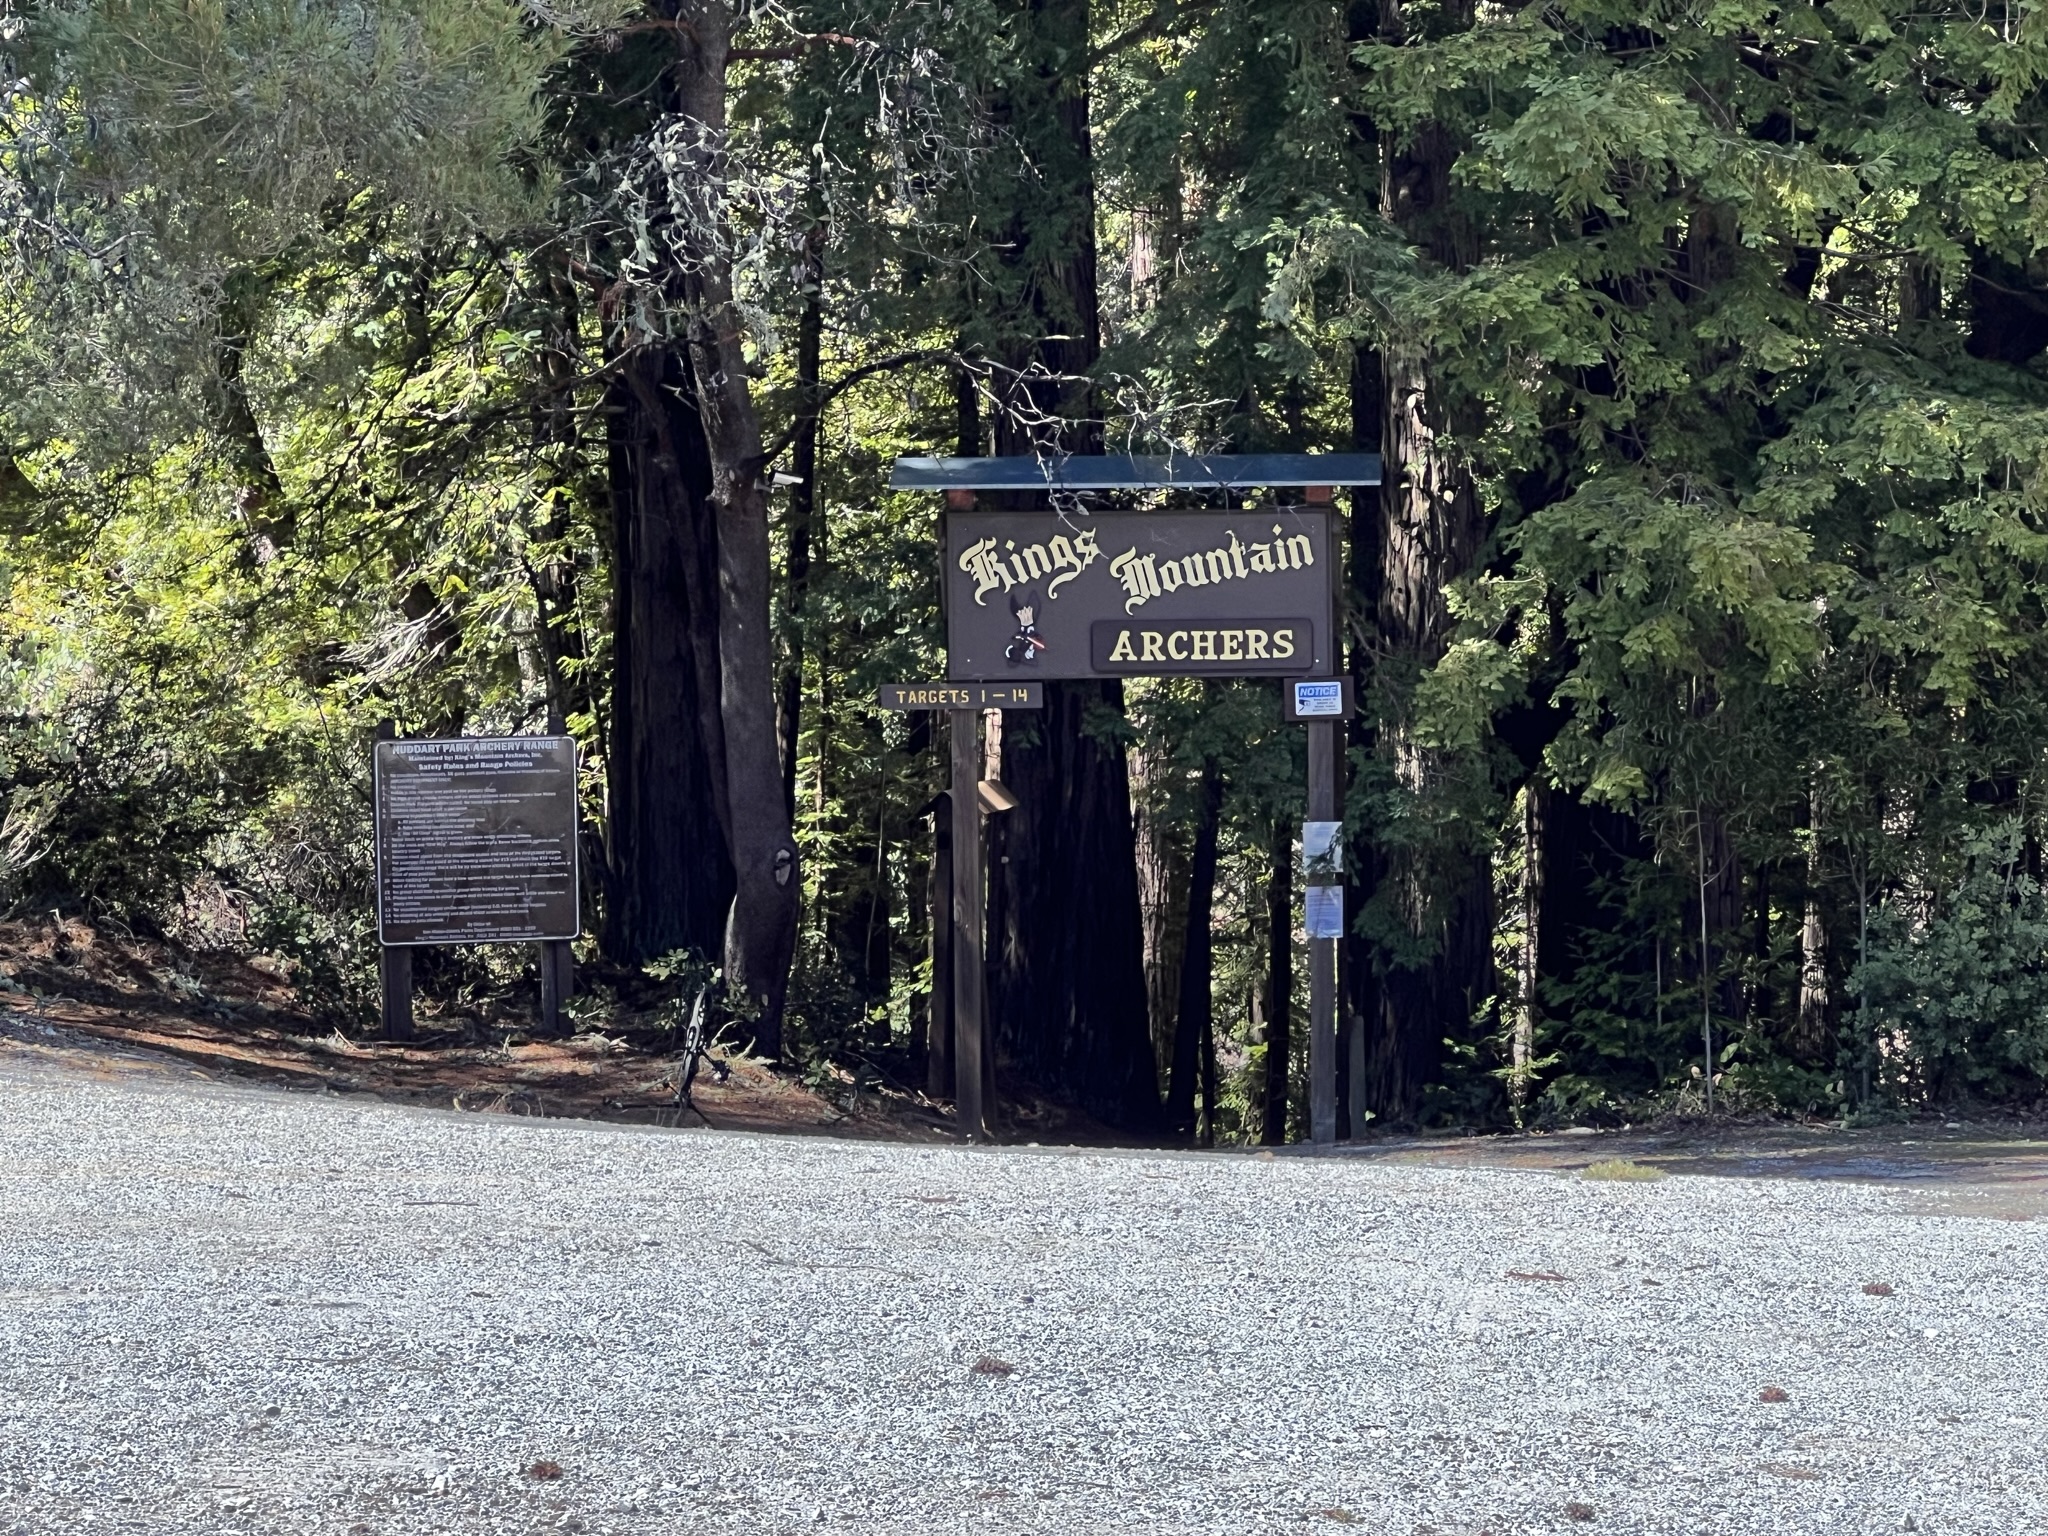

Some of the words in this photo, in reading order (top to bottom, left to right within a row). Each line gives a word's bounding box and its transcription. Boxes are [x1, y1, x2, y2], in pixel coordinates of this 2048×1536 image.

[959, 527, 1100, 606] Kings
[1109, 524, 1314, 616] Mountain
[1109, 629, 1295, 662] ARCHERS
[896, 689, 970, 704] TARGETS
[1012, 688, 1028, 702] 14
[1300, 687, 1337, 696] NOTICE
[392, 744, 441, 755] HUDDART
[442, 743, 470, 753] PARK
[473, 742, 521, 751] ARCHERY
[523, 740, 559, 750] RANGE
[418, 763, 442, 771] Safety
[480, 761, 503, 769] Range
